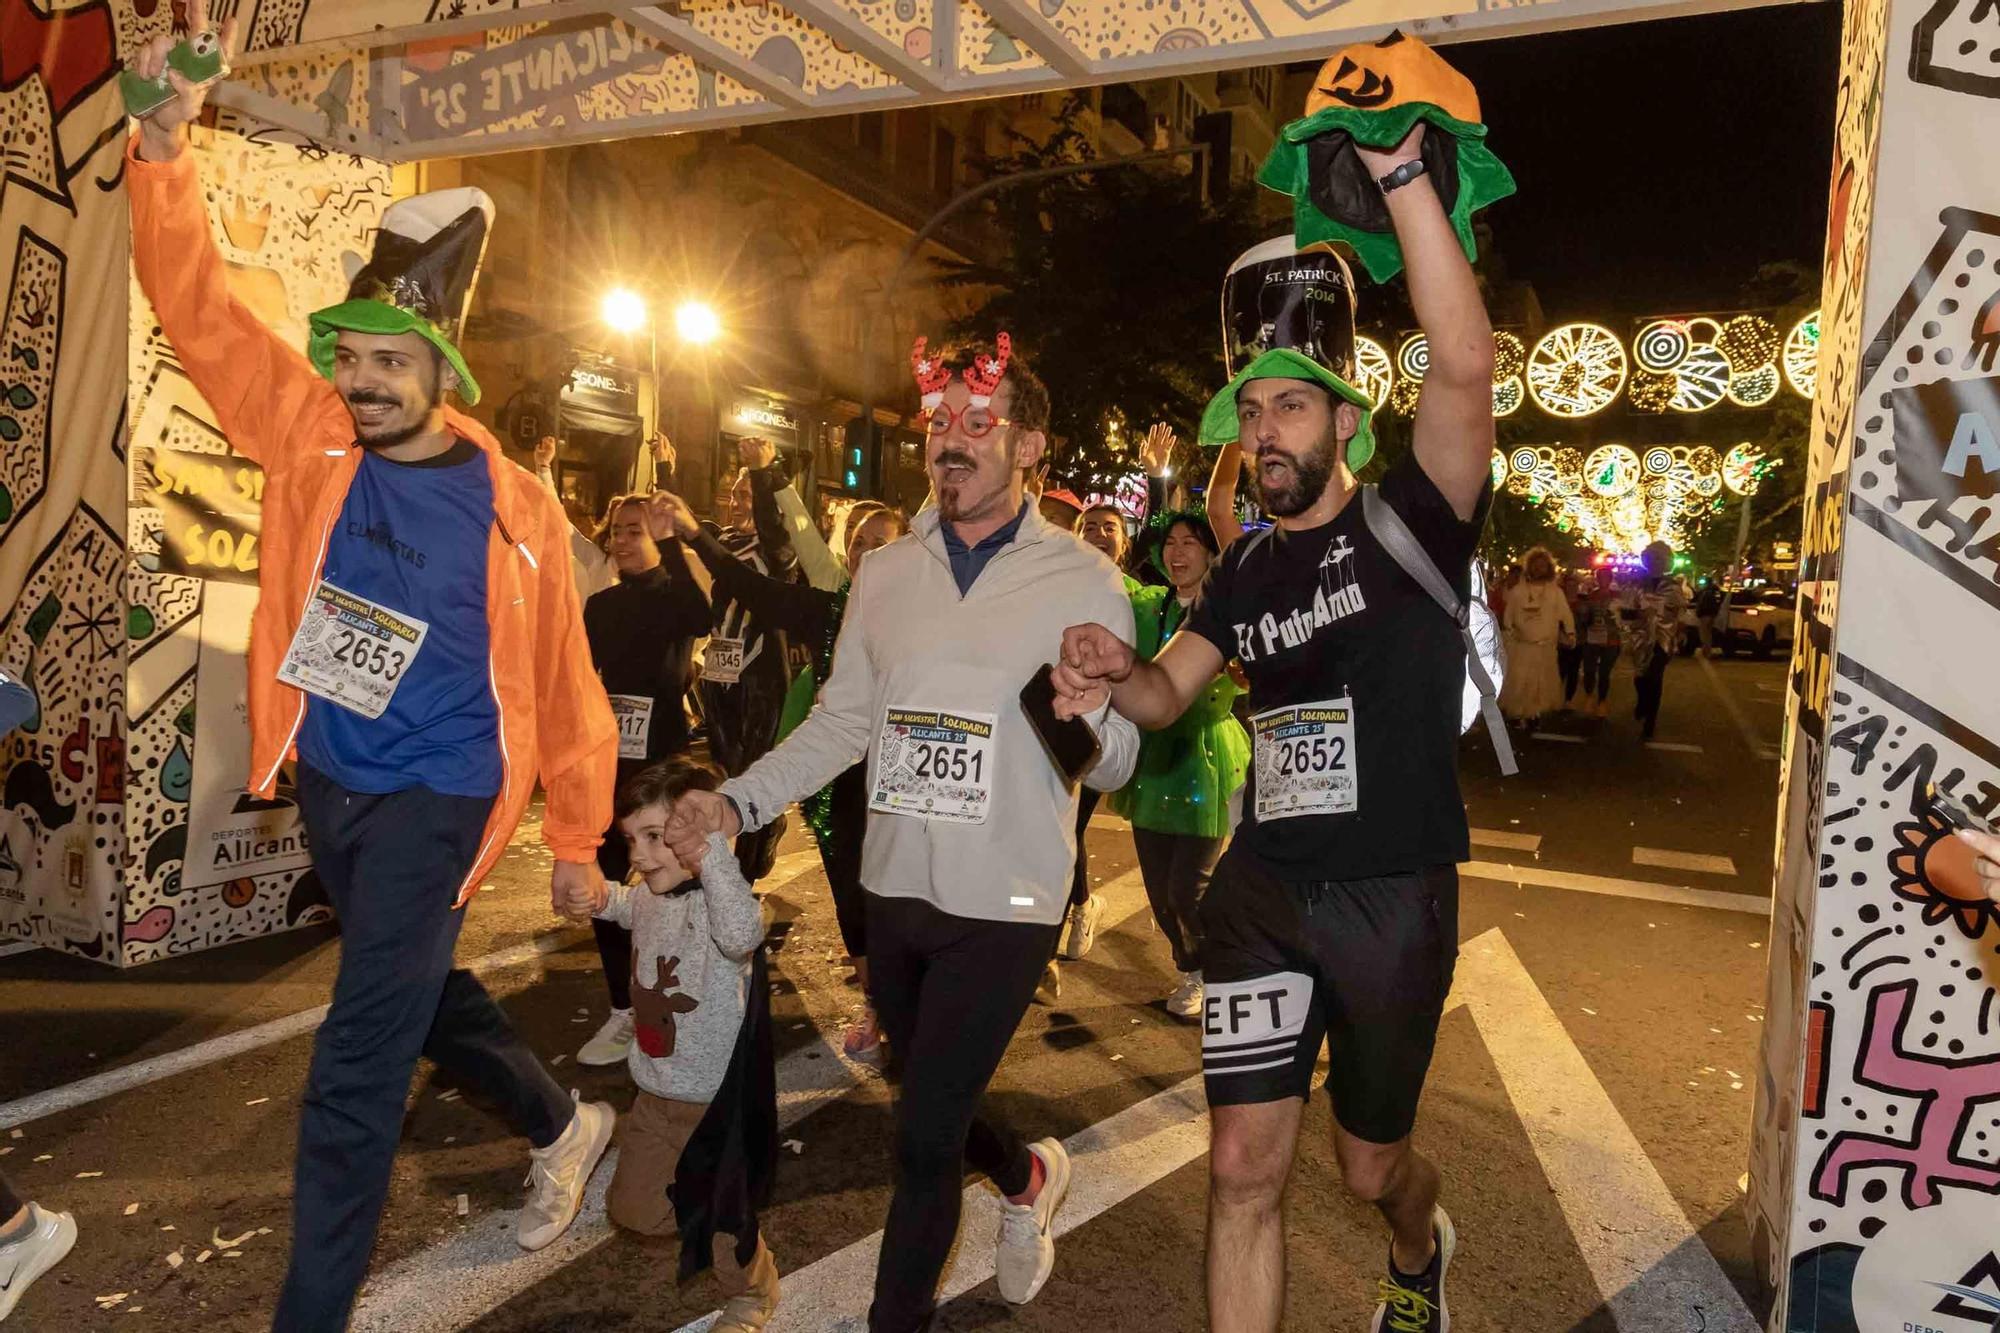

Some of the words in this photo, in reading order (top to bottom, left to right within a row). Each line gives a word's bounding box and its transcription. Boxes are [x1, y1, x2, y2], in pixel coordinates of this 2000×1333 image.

[1265, 271, 1284, 285] ST.
[1305, 287, 1335, 303] 2014
[319, 588, 334, 600] SAN
[335, 594, 370, 616] SILVESTRE
[374, 610, 418, 641] SOLIDARIA
[339, 612, 379, 634] ALICANTE
[333, 630, 406, 681] 2653
[716, 653, 740, 668] 1345
[889, 712, 903, 721] SAN
[904, 713, 937, 724] SILVESTRE
[943, 716, 989, 735] SOLIDARIA
[1301, 710, 1346, 721] SOLIDARIA
[911, 728, 951, 741] ALICANTE
[1276, 725, 1310, 737] ALICANTE
[916, 743, 983, 783] 2651
[1280, 736, 1346, 776] 2652
[212, 824, 273, 841] DEPORTES
[1205, 988, 1288, 1035] EFT
